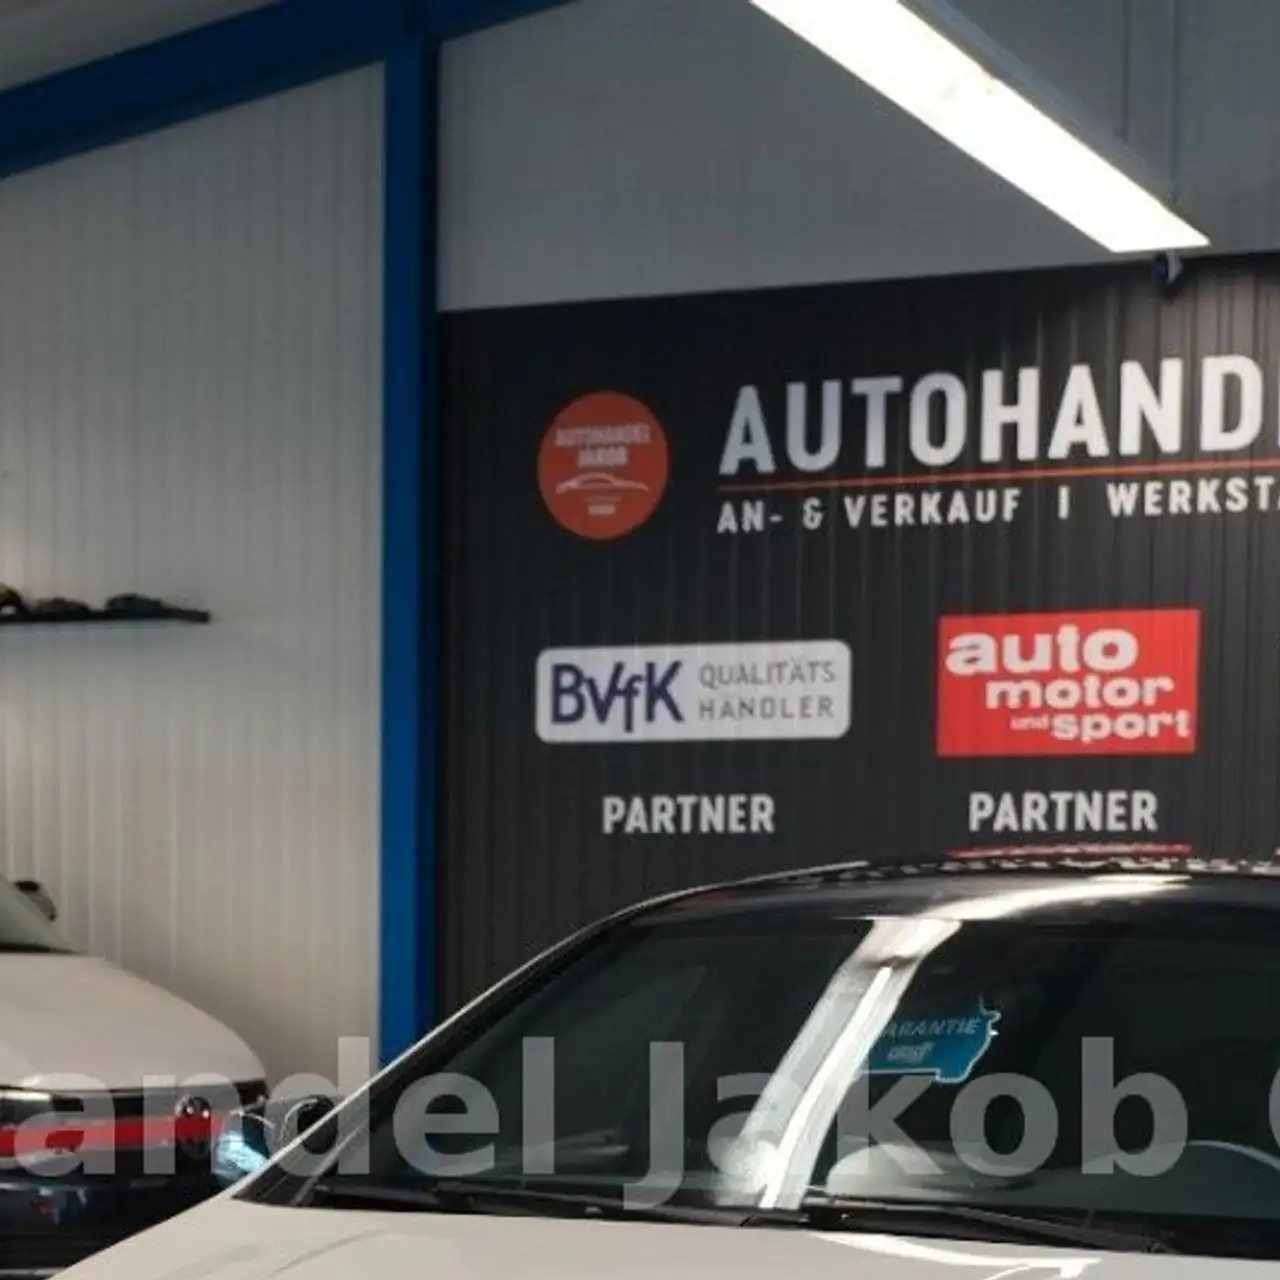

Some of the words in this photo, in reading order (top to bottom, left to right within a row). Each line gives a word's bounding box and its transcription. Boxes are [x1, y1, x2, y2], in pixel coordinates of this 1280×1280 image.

[717, 500, 782, 533] AN-
[802, 497, 823, 530] &
[843, 488, 1022, 528] VERKAUF
[945, 623, 1139, 676] auto
[985, 674, 1175, 710] motor
[1050, 709, 1191, 744] sport
[603, 794, 775, 834] PARTNER
[969, 790, 1158, 832] PARTNER
[883, 1017, 981, 1037] ARANTIE
